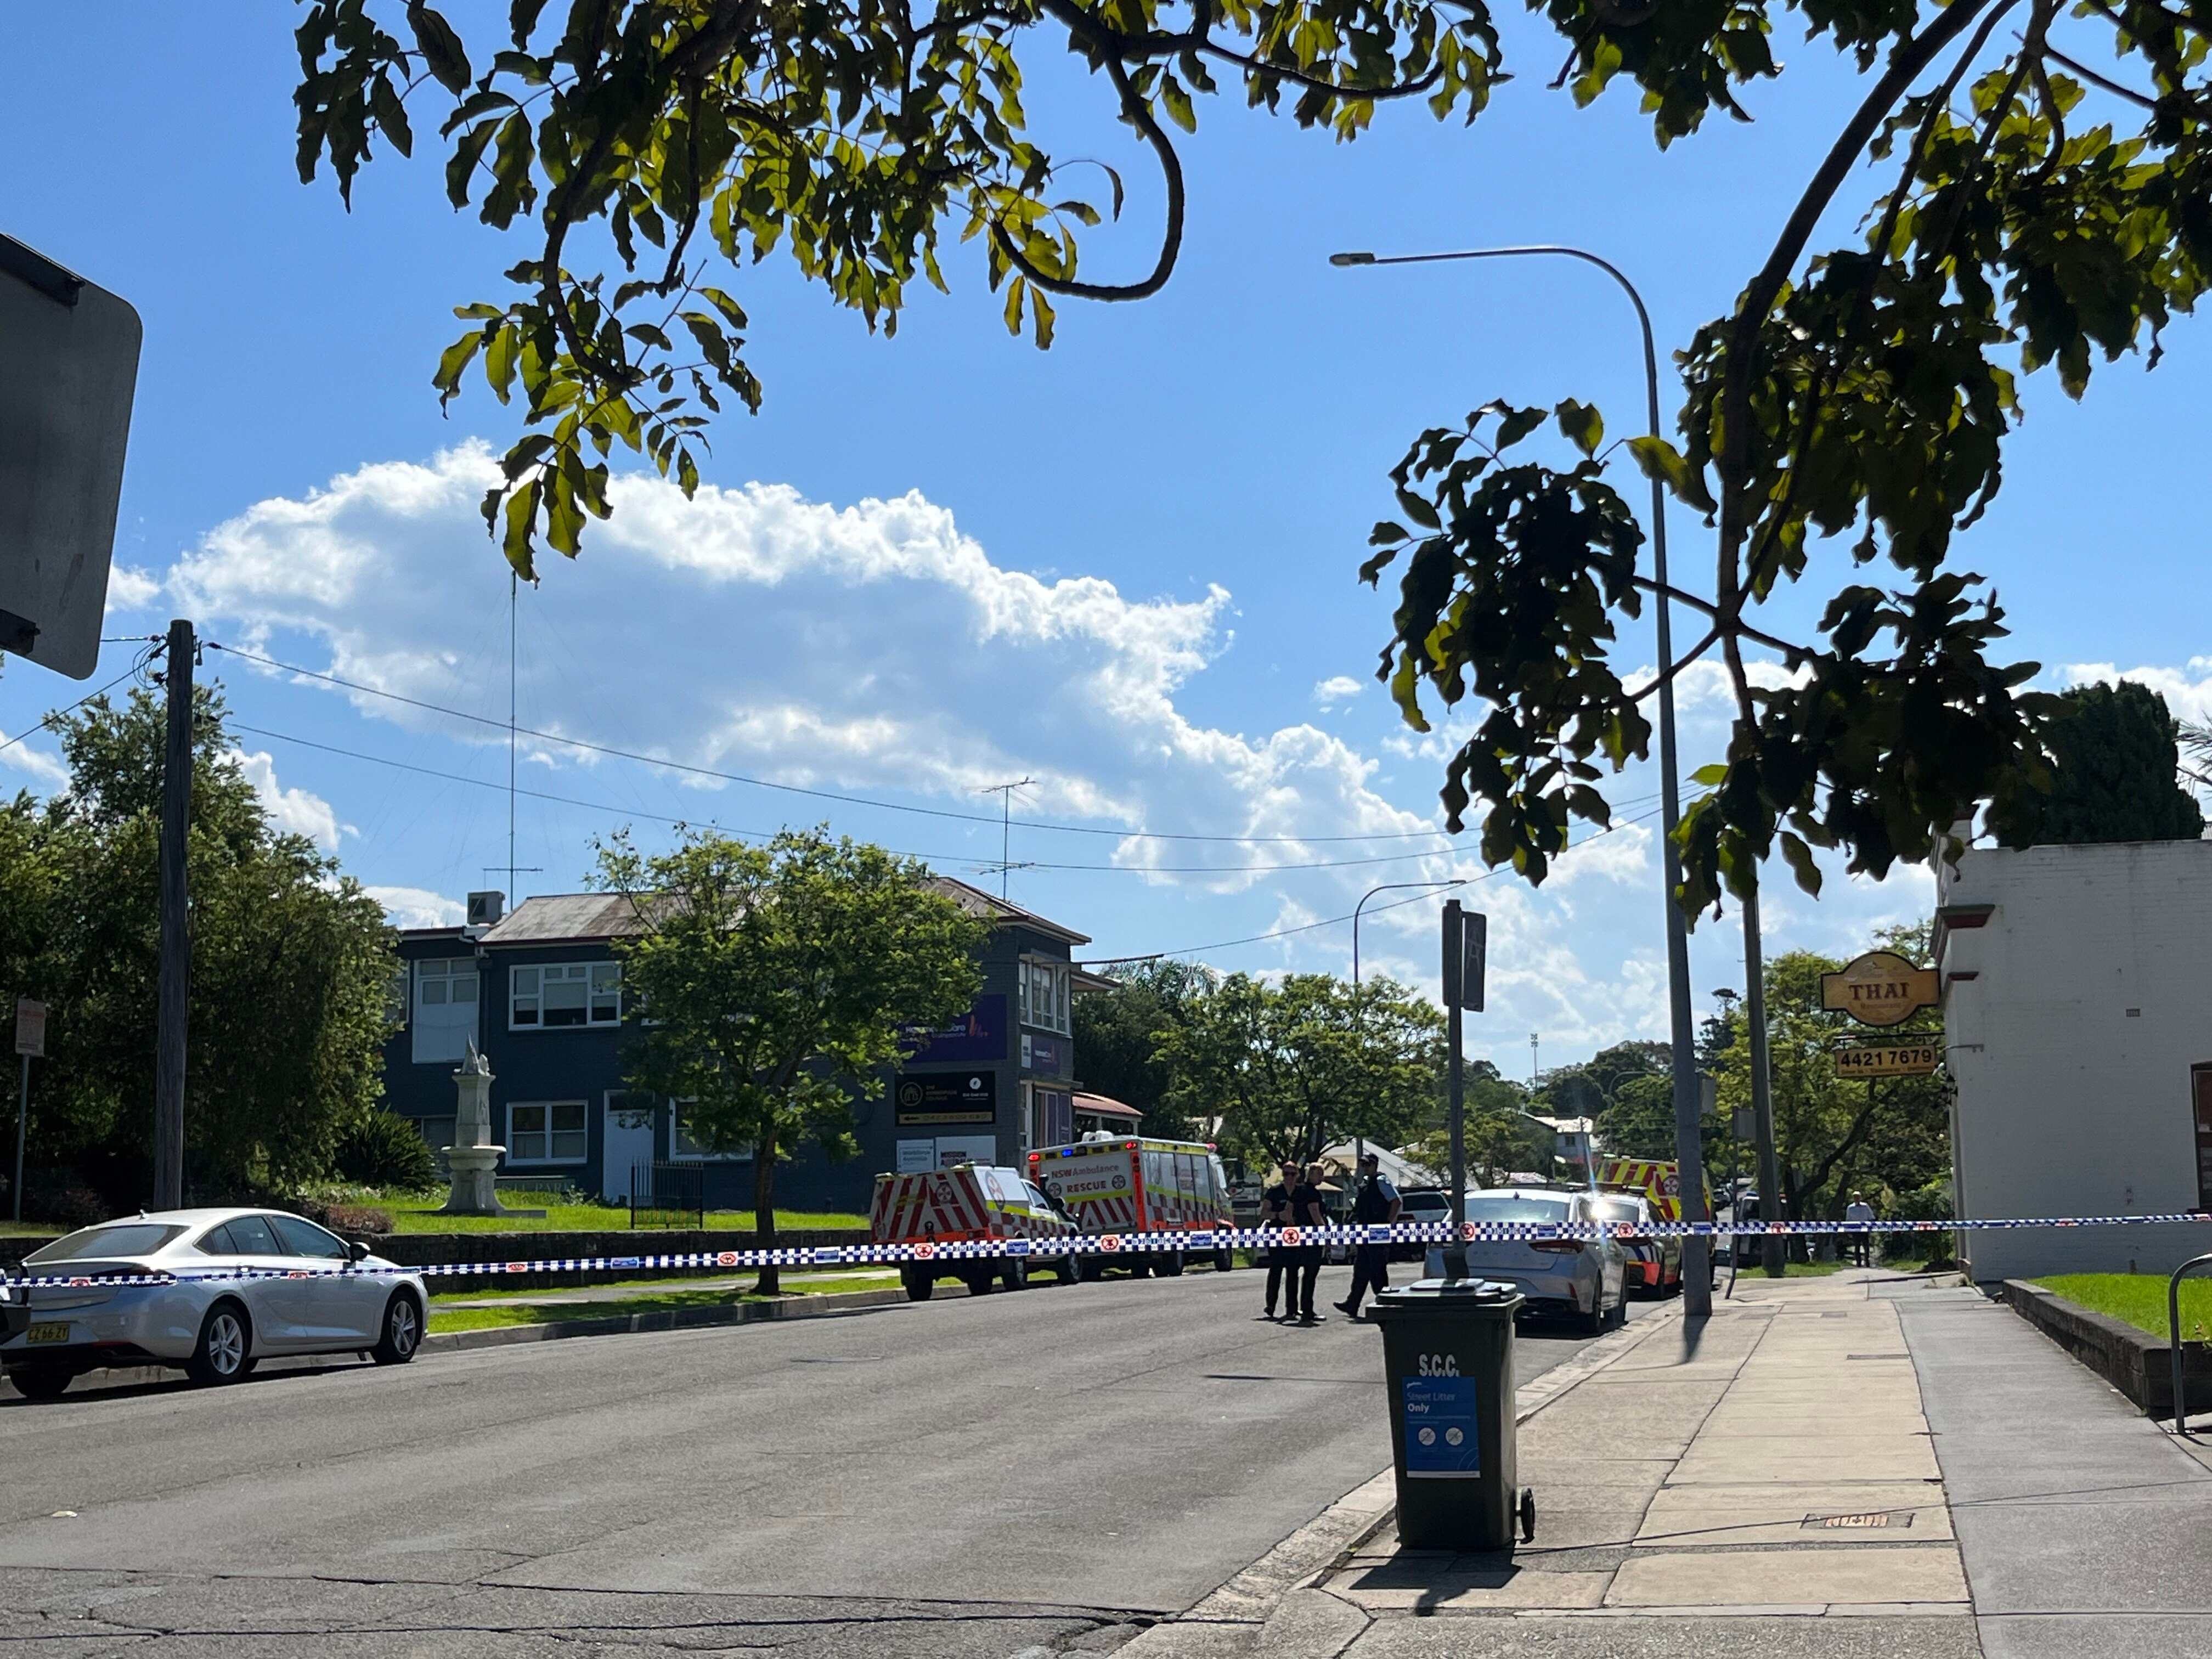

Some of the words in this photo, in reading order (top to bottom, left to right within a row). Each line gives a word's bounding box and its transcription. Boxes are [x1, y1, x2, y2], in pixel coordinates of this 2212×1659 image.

[1848, 982, 1910, 1000] THAI
[1841, 1052, 1883, 1067] 4421
[1888, 1049, 1932, 1064] 7679
[1051, 1169, 1071, 1179] NSW
[1072, 1164, 1119, 1176] Ambulance
[1066, 1180, 1107, 1193] RESCUE
[1419, 1353, 1460, 1378] S.C.C.
[1407, 1392, 1431, 1401] Street
[1433, 1392, 1456, 1401] Litter
[1407, 1403, 1430, 1414] Only
